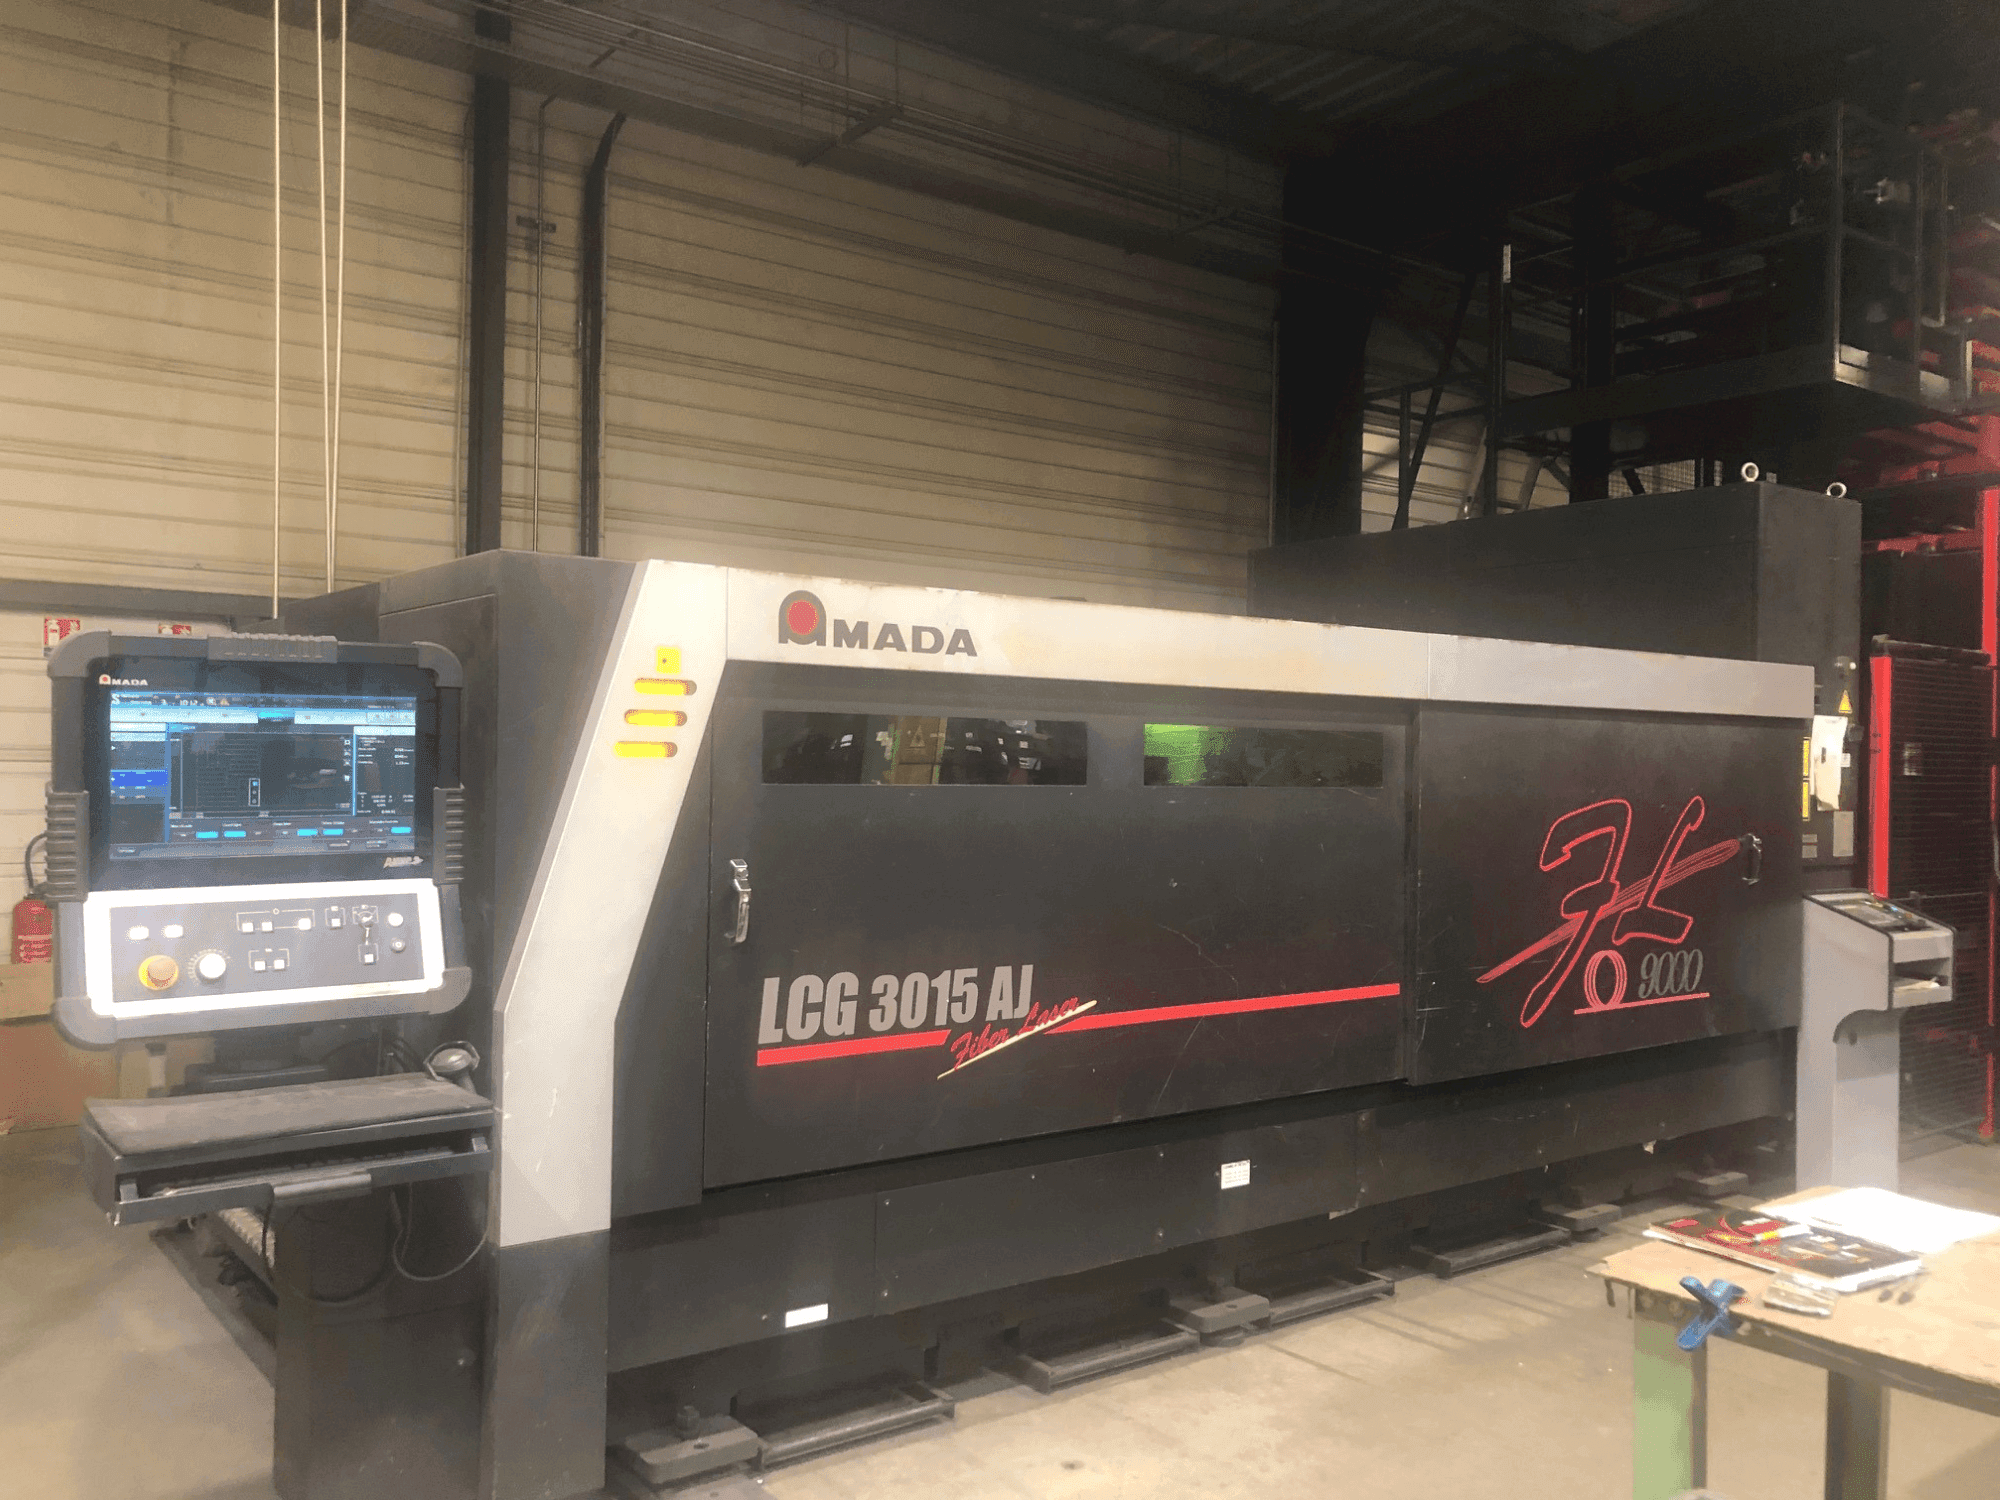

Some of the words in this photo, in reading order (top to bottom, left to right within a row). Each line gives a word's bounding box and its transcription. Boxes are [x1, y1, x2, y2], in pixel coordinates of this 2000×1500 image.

[778, 590, 978, 657] AMADA
[99, 674, 148, 686] AMADA
[1638, 945, 1704, 999] 9000
[758, 972, 859, 1045] LCG
[869, 968, 979, 1033] 3015
[985, 964, 1034, 1022] AJ
[950, 1023, 1010, 1070] Fiber
